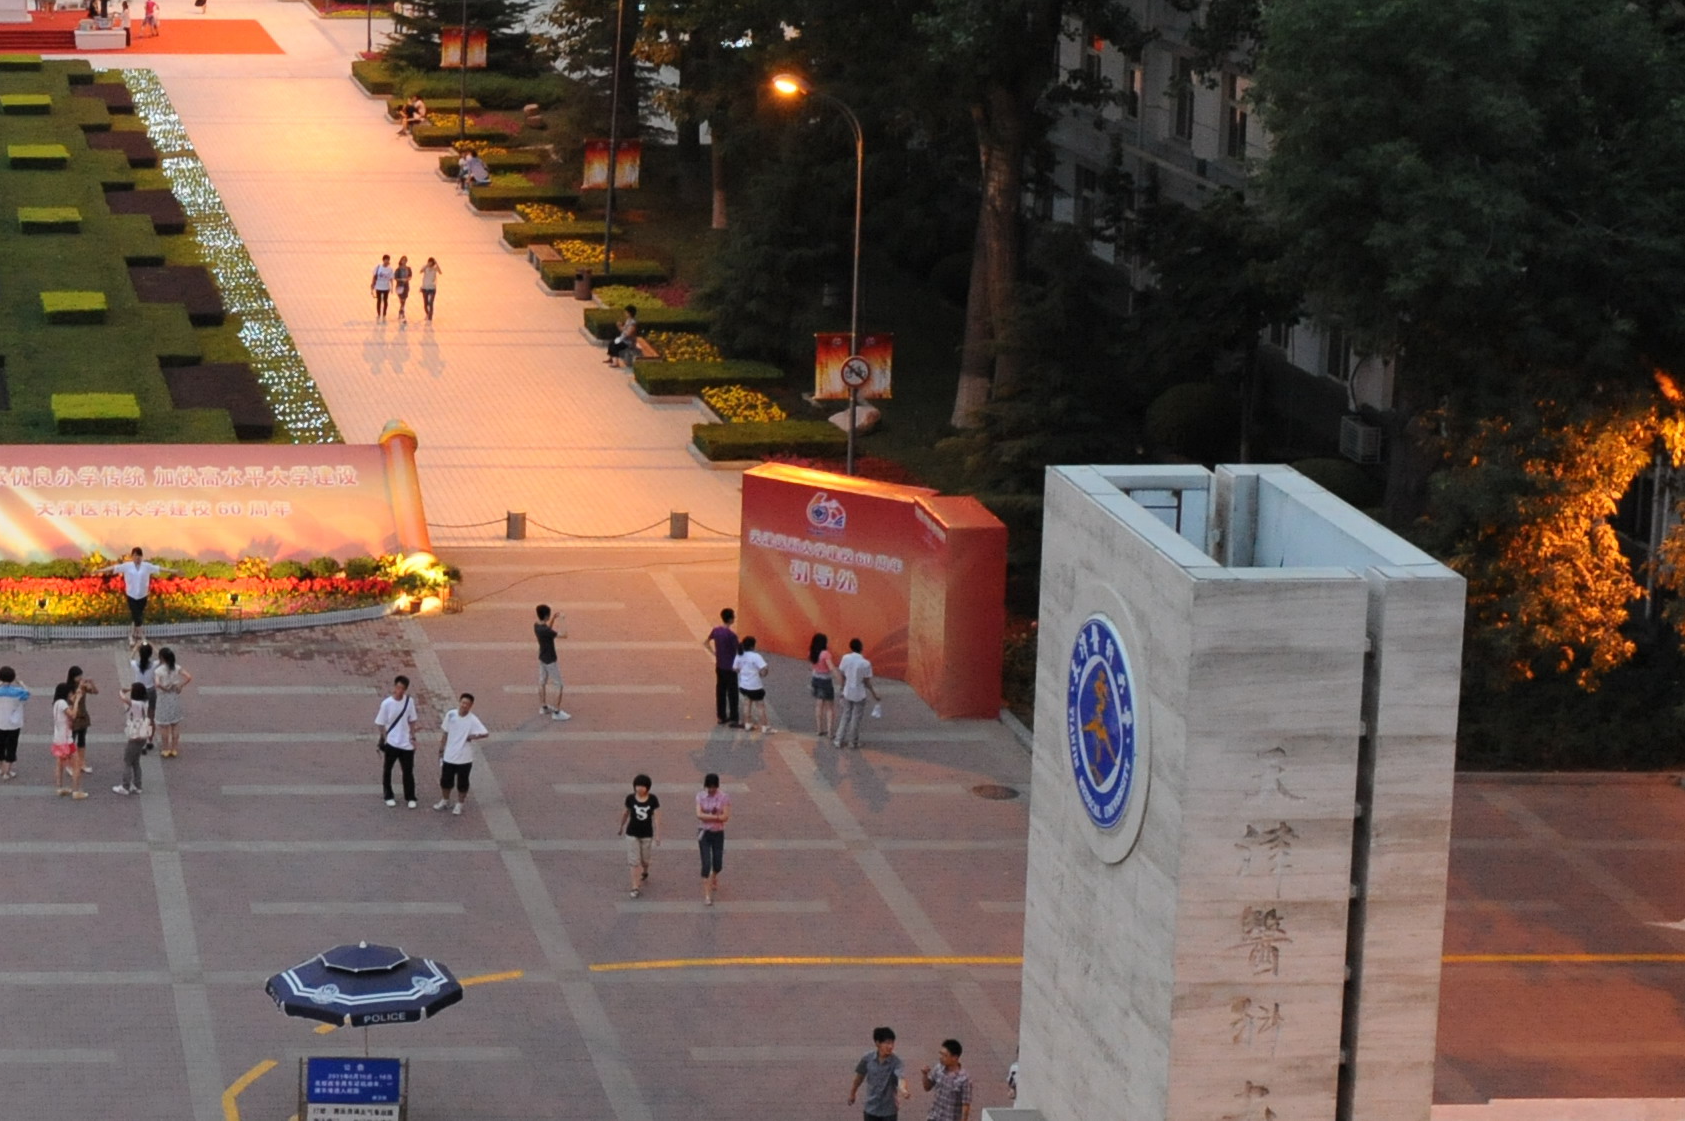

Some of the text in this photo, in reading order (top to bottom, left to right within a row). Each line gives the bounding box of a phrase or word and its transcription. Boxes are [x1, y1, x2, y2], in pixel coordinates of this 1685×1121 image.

[153, 465, 358, 488] 加快高水平大学建设
[36, 500, 292, 518] 天津医科大学建校 60 周年
[363, 1011, 407, 1023] POLICE
